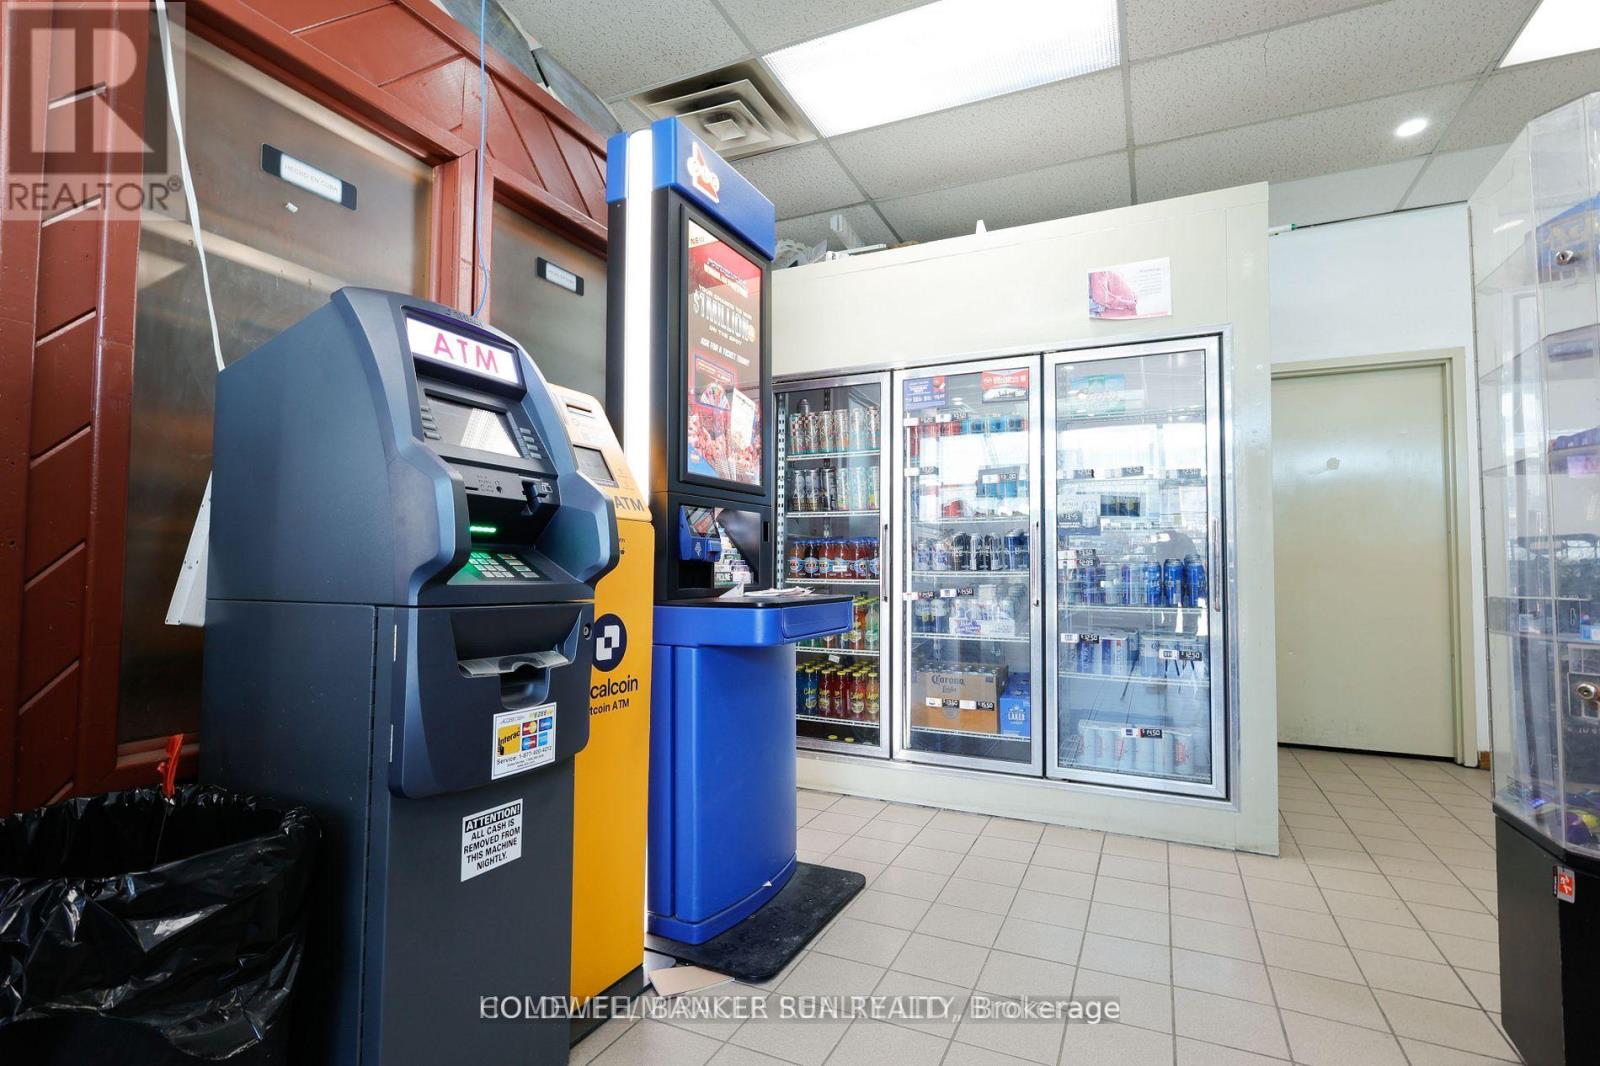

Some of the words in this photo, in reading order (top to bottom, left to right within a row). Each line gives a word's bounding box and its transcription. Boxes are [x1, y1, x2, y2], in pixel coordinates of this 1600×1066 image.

[433, 333, 498, 373] ATM
[614, 495, 645, 512] ATM
[590, 674, 639, 699] calcoin
[931, 674, 965, 687] Corona
[590, 703, 611, 716] tcoin
[612, 698, 630, 711] ATM
[498, 728, 521, 746] Interac
[466, 804, 520, 831] ATTENTION!
[464, 834, 499, 854] REMOVED
[501, 826, 520, 839] FROM
[472, 829, 485, 841] ALL
[487, 822, 506, 835] CASH
[508, 818, 515, 828] IS
[467, 850, 483, 863] THIS
[485, 837, 518, 856] MACHINE
[476, 851, 508, 870] NIGHTLY.
